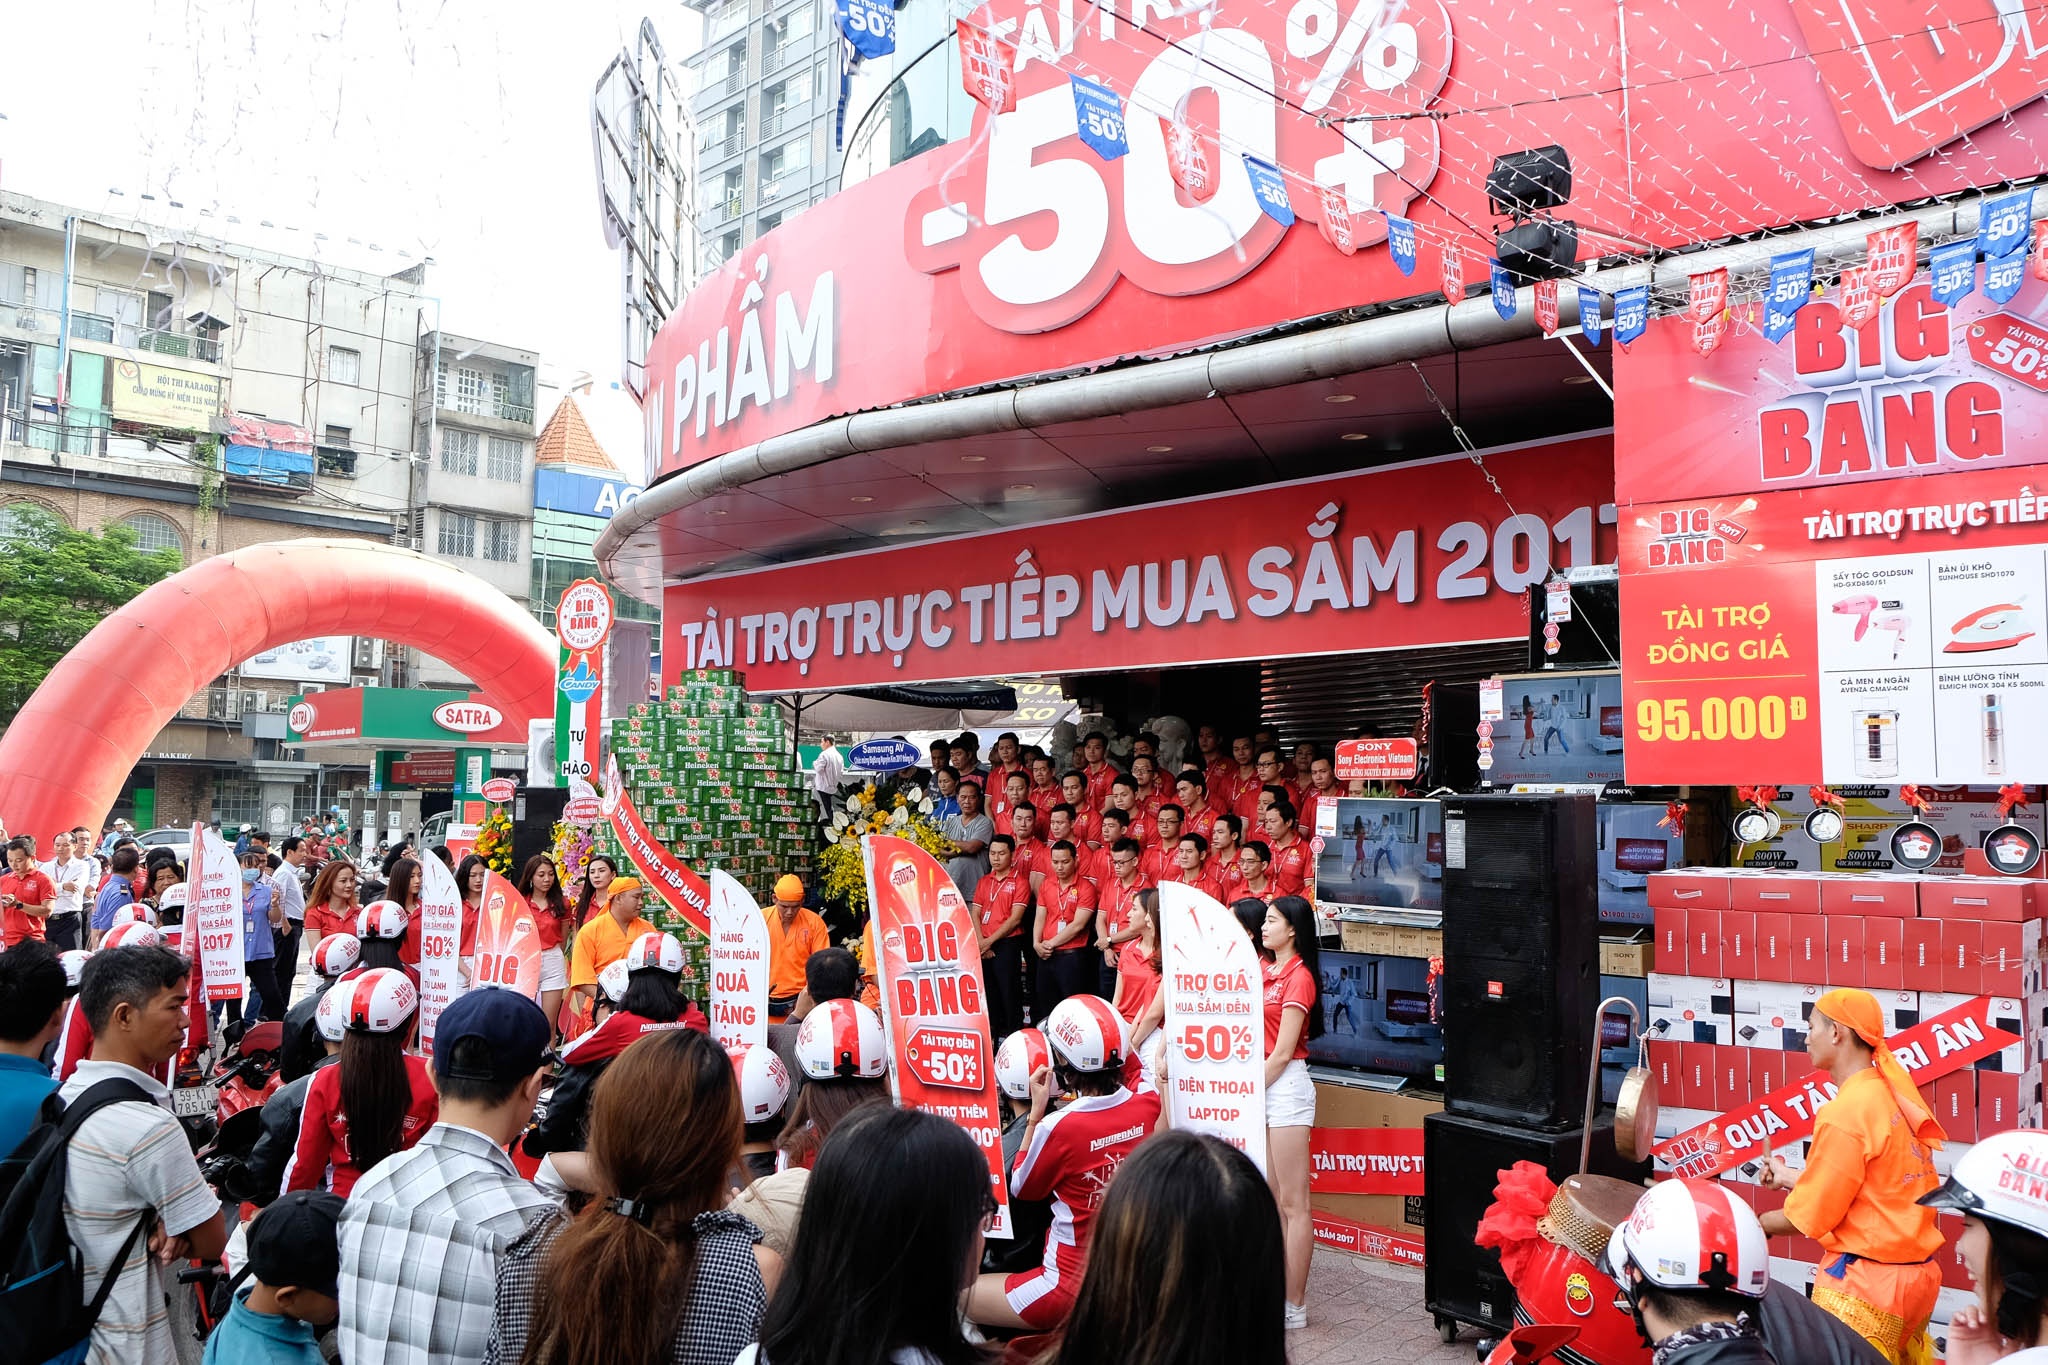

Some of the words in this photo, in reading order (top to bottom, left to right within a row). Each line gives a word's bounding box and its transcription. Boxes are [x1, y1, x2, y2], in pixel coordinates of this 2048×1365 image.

[1877, 237, 1900, 254] BIG
[1870, 253, 1905, 272] BANG
[1795, 283, 1952, 377] BIG
[2007, 325, 2024, 338] TÀI
[2023, 332, 2046, 348] TRỢ
[673, 252, 834, 456] PHẨM
[157, 374, 170, 386] HỘI
[171, 377, 183, 387] THI
[184, 379, 218, 393] KARAOKE
[1760, 382, 2005, 481] BANG
[1659, 507, 1711, 535] BIG
[1803, 509, 1843, 541] TÀI
[1845, 506, 1902, 537] TRỢ
[1909, 501, 1987, 537] TRỰC
[1718, 522, 1741, 539] 2017
[1648, 537, 1725, 568] BANG
[1851, 570, 1870, 580] TÓC
[1872, 568, 1914, 578] GOLDSUN
[1938, 565, 1958, 573] BÀN
[1972, 562, 1992, 571] KHÔ
[1938, 572, 1979, 581] SUNHOUSE
[681, 606, 733, 670] TÀI
[740, 606, 821, 676] TRỢ
[827, 589, 953, 668] TRỰC
[960, 548, 1081, 644] TIẾP
[1091, 554, 1237, 633] MUA
[1247, 501, 1416, 618] SẮM
[575, 599, 594, 613] BIG
[570, 616, 598, 630] BANG
[1662, 606, 1704, 631] TÀI
[1711, 600, 1772, 631] TRỢ
[1646, 637, 1730, 666] ĐỒNG
[1738, 633, 1790, 660] GIÁ
[1998, 672, 2020, 680] TÍNH
[291, 708, 308, 727] SATRA
[445, 708, 492, 726] SATRA
[570, 729, 586, 745] TỰ
[735, 745, 768, 753] Heineken
[862, 744, 894, 754] Samsung
[895, 743, 905, 752] AV
[1356, 743, 1393, 751] SONY
[159, 752, 193, 760] BAKERY
[1337, 755, 1353, 766] Sony
[1354, 754, 1386, 764] Electronics
[1388, 753, 1413, 764] Vietnam
[562, 761, 591, 776] HÀO
[766, 798, 797, 806] Heineken
[617, 805, 629, 824] TÀI
[625, 821, 640, 845] TRỢ
[637, 840, 661, 872] TRỰC
[658, 864, 684, 891] TIẾP
[679, 885, 706, 912] MUA
[1755, 851, 1784, 860] 800W
[1847, 850, 1878, 860] 800W
[210, 887, 231, 901] TRỢ
[215, 902, 232, 912] TIẾP
[424, 903, 437, 920] TRỢ
[438, 902, 455, 917] GIÁ
[215, 916, 233, 927] SẮM
[203, 933, 233, 950] 2017
[720, 931, 744, 943] HÀNG
[903, 922, 959, 963] BIG
[713, 949, 730, 960] TRĂM
[1613, 951, 1636, 959] SONY
[429, 968, 440, 977] TIVI
[479, 953, 519, 985] BIG
[431, 982, 447, 993] LẠNH
[716, 968, 750, 993] QUÀ
[1175, 973, 1209, 996] TRỢ
[1213, 969, 1250, 992] GIÁ
[432, 995, 449, 1006] LẠNH
[896, 975, 982, 1016] BANG
[1175, 1003, 1194, 1013] MUA
[1198, 998, 1222, 1013] SẮM
[1226, 998, 1251, 1013] ĐẾN
[713, 1000, 756, 1029] TẶNG
[1062, 1015, 1077, 1034] BIG
[921, 1033, 936, 1046] TÀI
[936, 1034, 955, 1050] TRỢ
[956, 1033, 975, 1050] ĐẾN
[1055, 1023, 1075, 1047] BANG
[1179, 1076, 1205, 1096] ĐIỆN
[1209, 1081, 1255, 1098] THOẠI
[1724, 1104, 1788, 1149] QUÀ
[1892, 1041, 1931, 1073] RI
[1930, 1016, 1985, 1058] ÂN
[179, 1088, 207, 1102] 59-K1
[936, 1106, 958, 1121] TRỢ
[959, 1104, 989, 1119] THÊM
[1188, 1106, 1240, 1122] LAPTOP
[1090, 1125, 1144, 1152] NguyenKim
[1669, 1136, 1700, 1160] BIG
[1312, 1150, 1336, 1171] TÀI
[1336, 1154, 1367, 1176] TRỢ
[1368, 1154, 1411, 1177] TRỰC
[1674, 1153, 1718, 1179] BANG
[1407, 1196, 1421, 1207] 40
[1318, 1227, 1336, 1240] SẮM
[1336, 1233, 1355, 1244] 2017
[1369, 1235, 1381, 1246] BIG
[1366, 1245, 1385, 1256] BANG
[1393, 1246, 1408, 1257] TÀI
